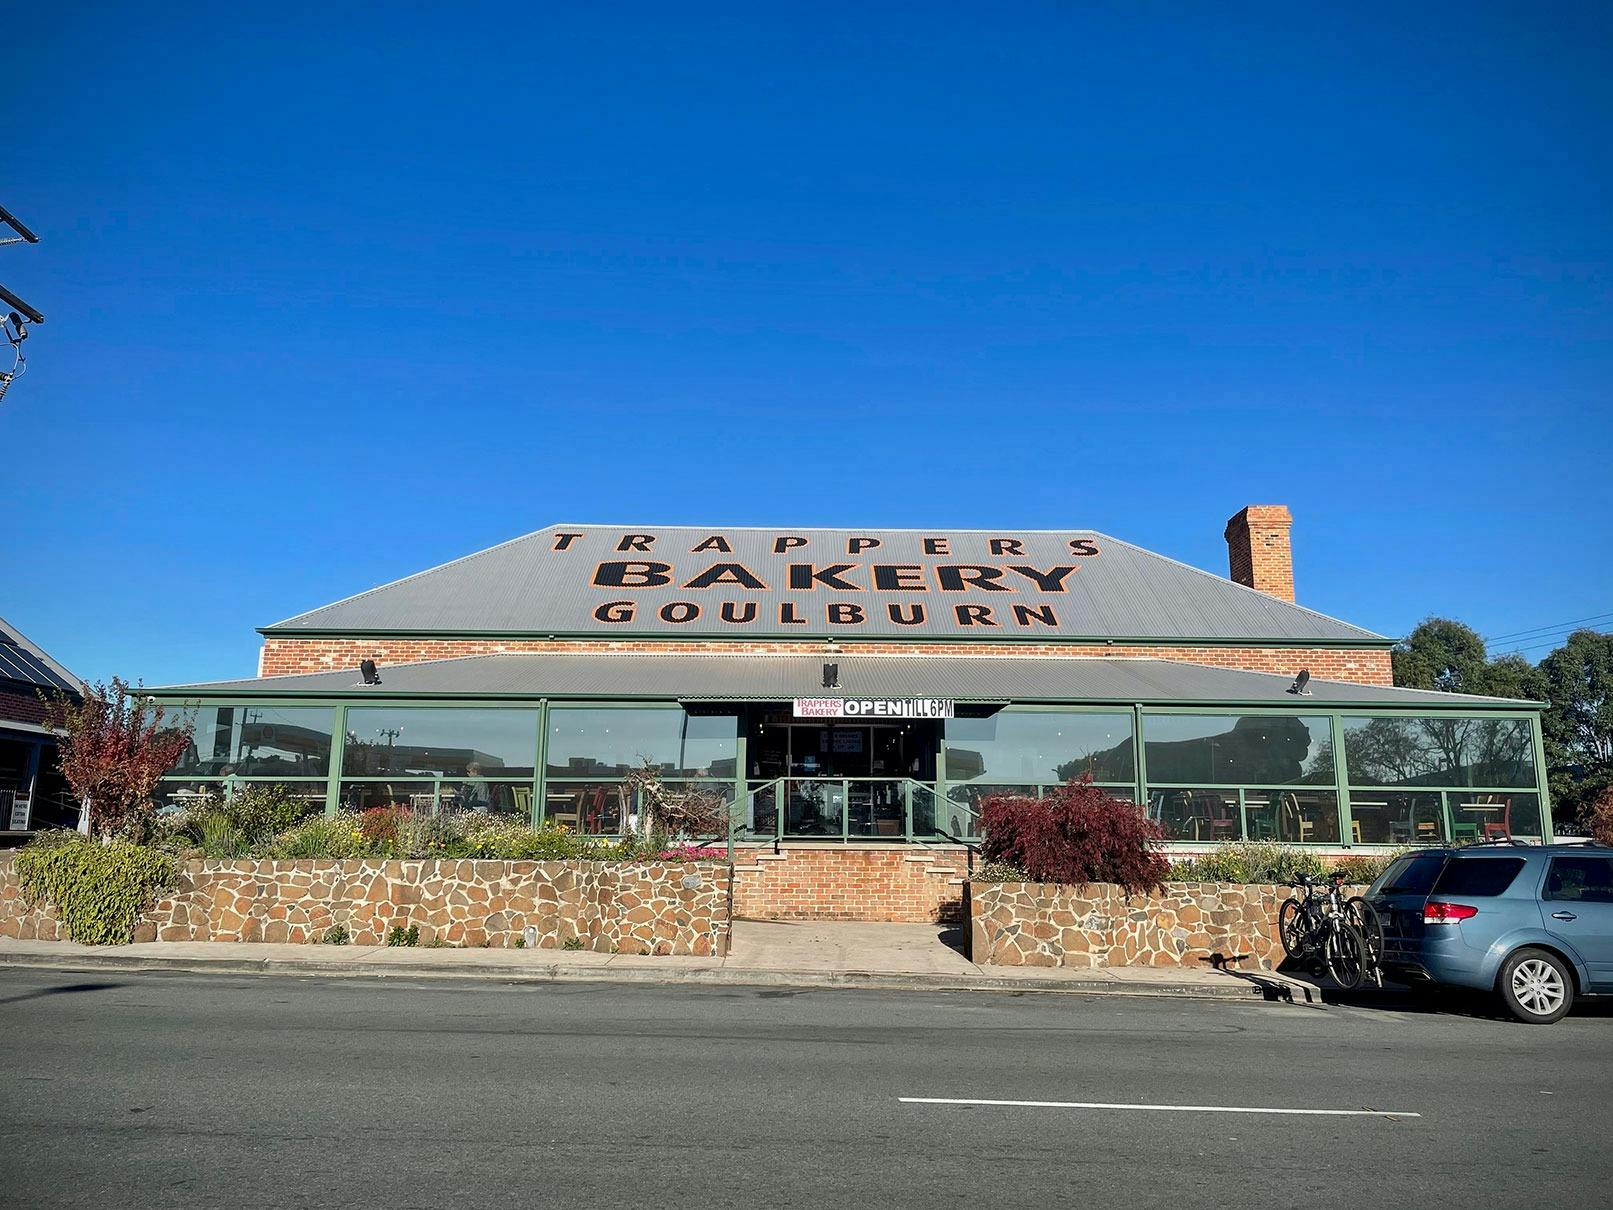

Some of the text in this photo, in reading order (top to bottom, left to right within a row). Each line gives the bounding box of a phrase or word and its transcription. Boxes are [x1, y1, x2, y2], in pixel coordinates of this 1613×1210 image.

[553, 532, 1100, 557] TRAPPERS
[591, 560, 1081, 594] BAKERY
[593, 600, 1060, 629] GOULBURN
[797, 698, 842, 707] TRAPPERS
[802, 707, 838, 716] BAKERY
[845, 699, 953, 717] OPEN TILL 6PM
